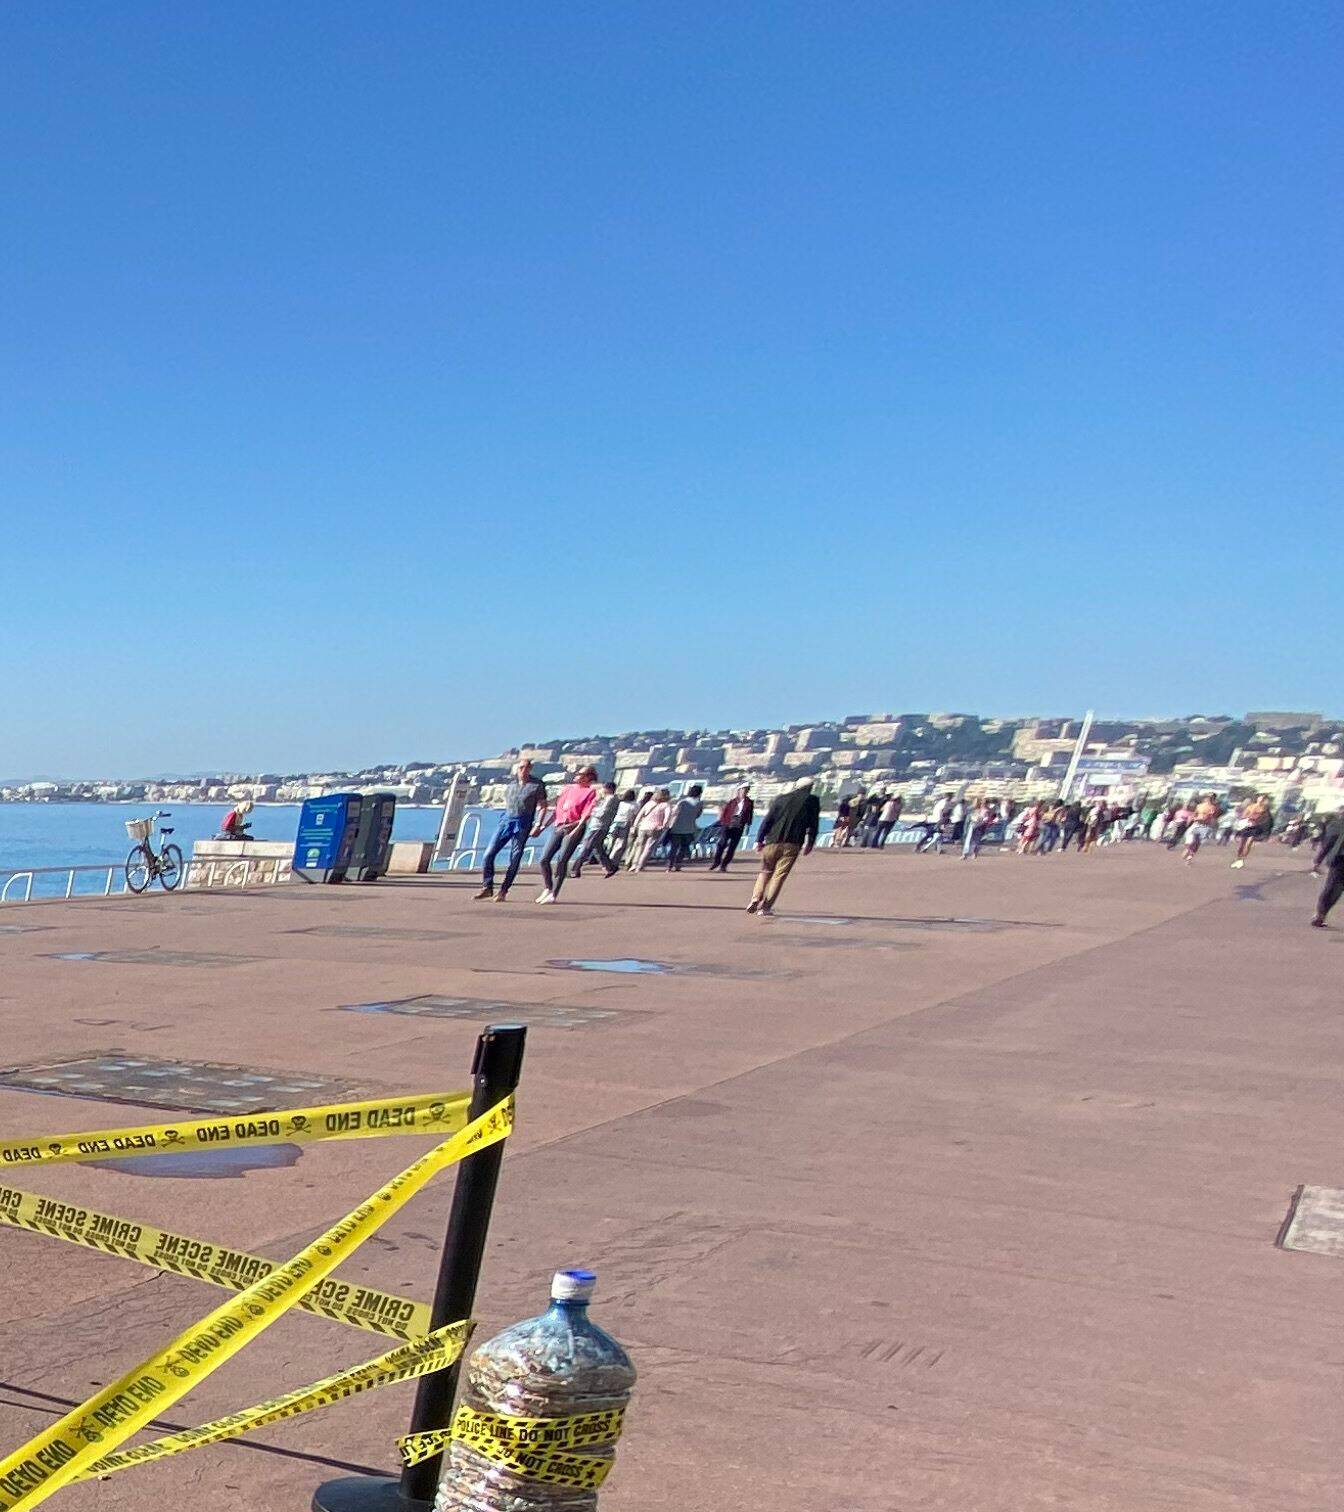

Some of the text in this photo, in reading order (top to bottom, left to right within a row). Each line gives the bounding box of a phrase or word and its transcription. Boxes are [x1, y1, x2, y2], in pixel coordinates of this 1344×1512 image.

[519, 1428, 538, 1442] DO
[544, 1427, 571, 1442] NOT
[573, 1420, 611, 1436] CROSS
[547, 1463, 584, 1478] CROSS
